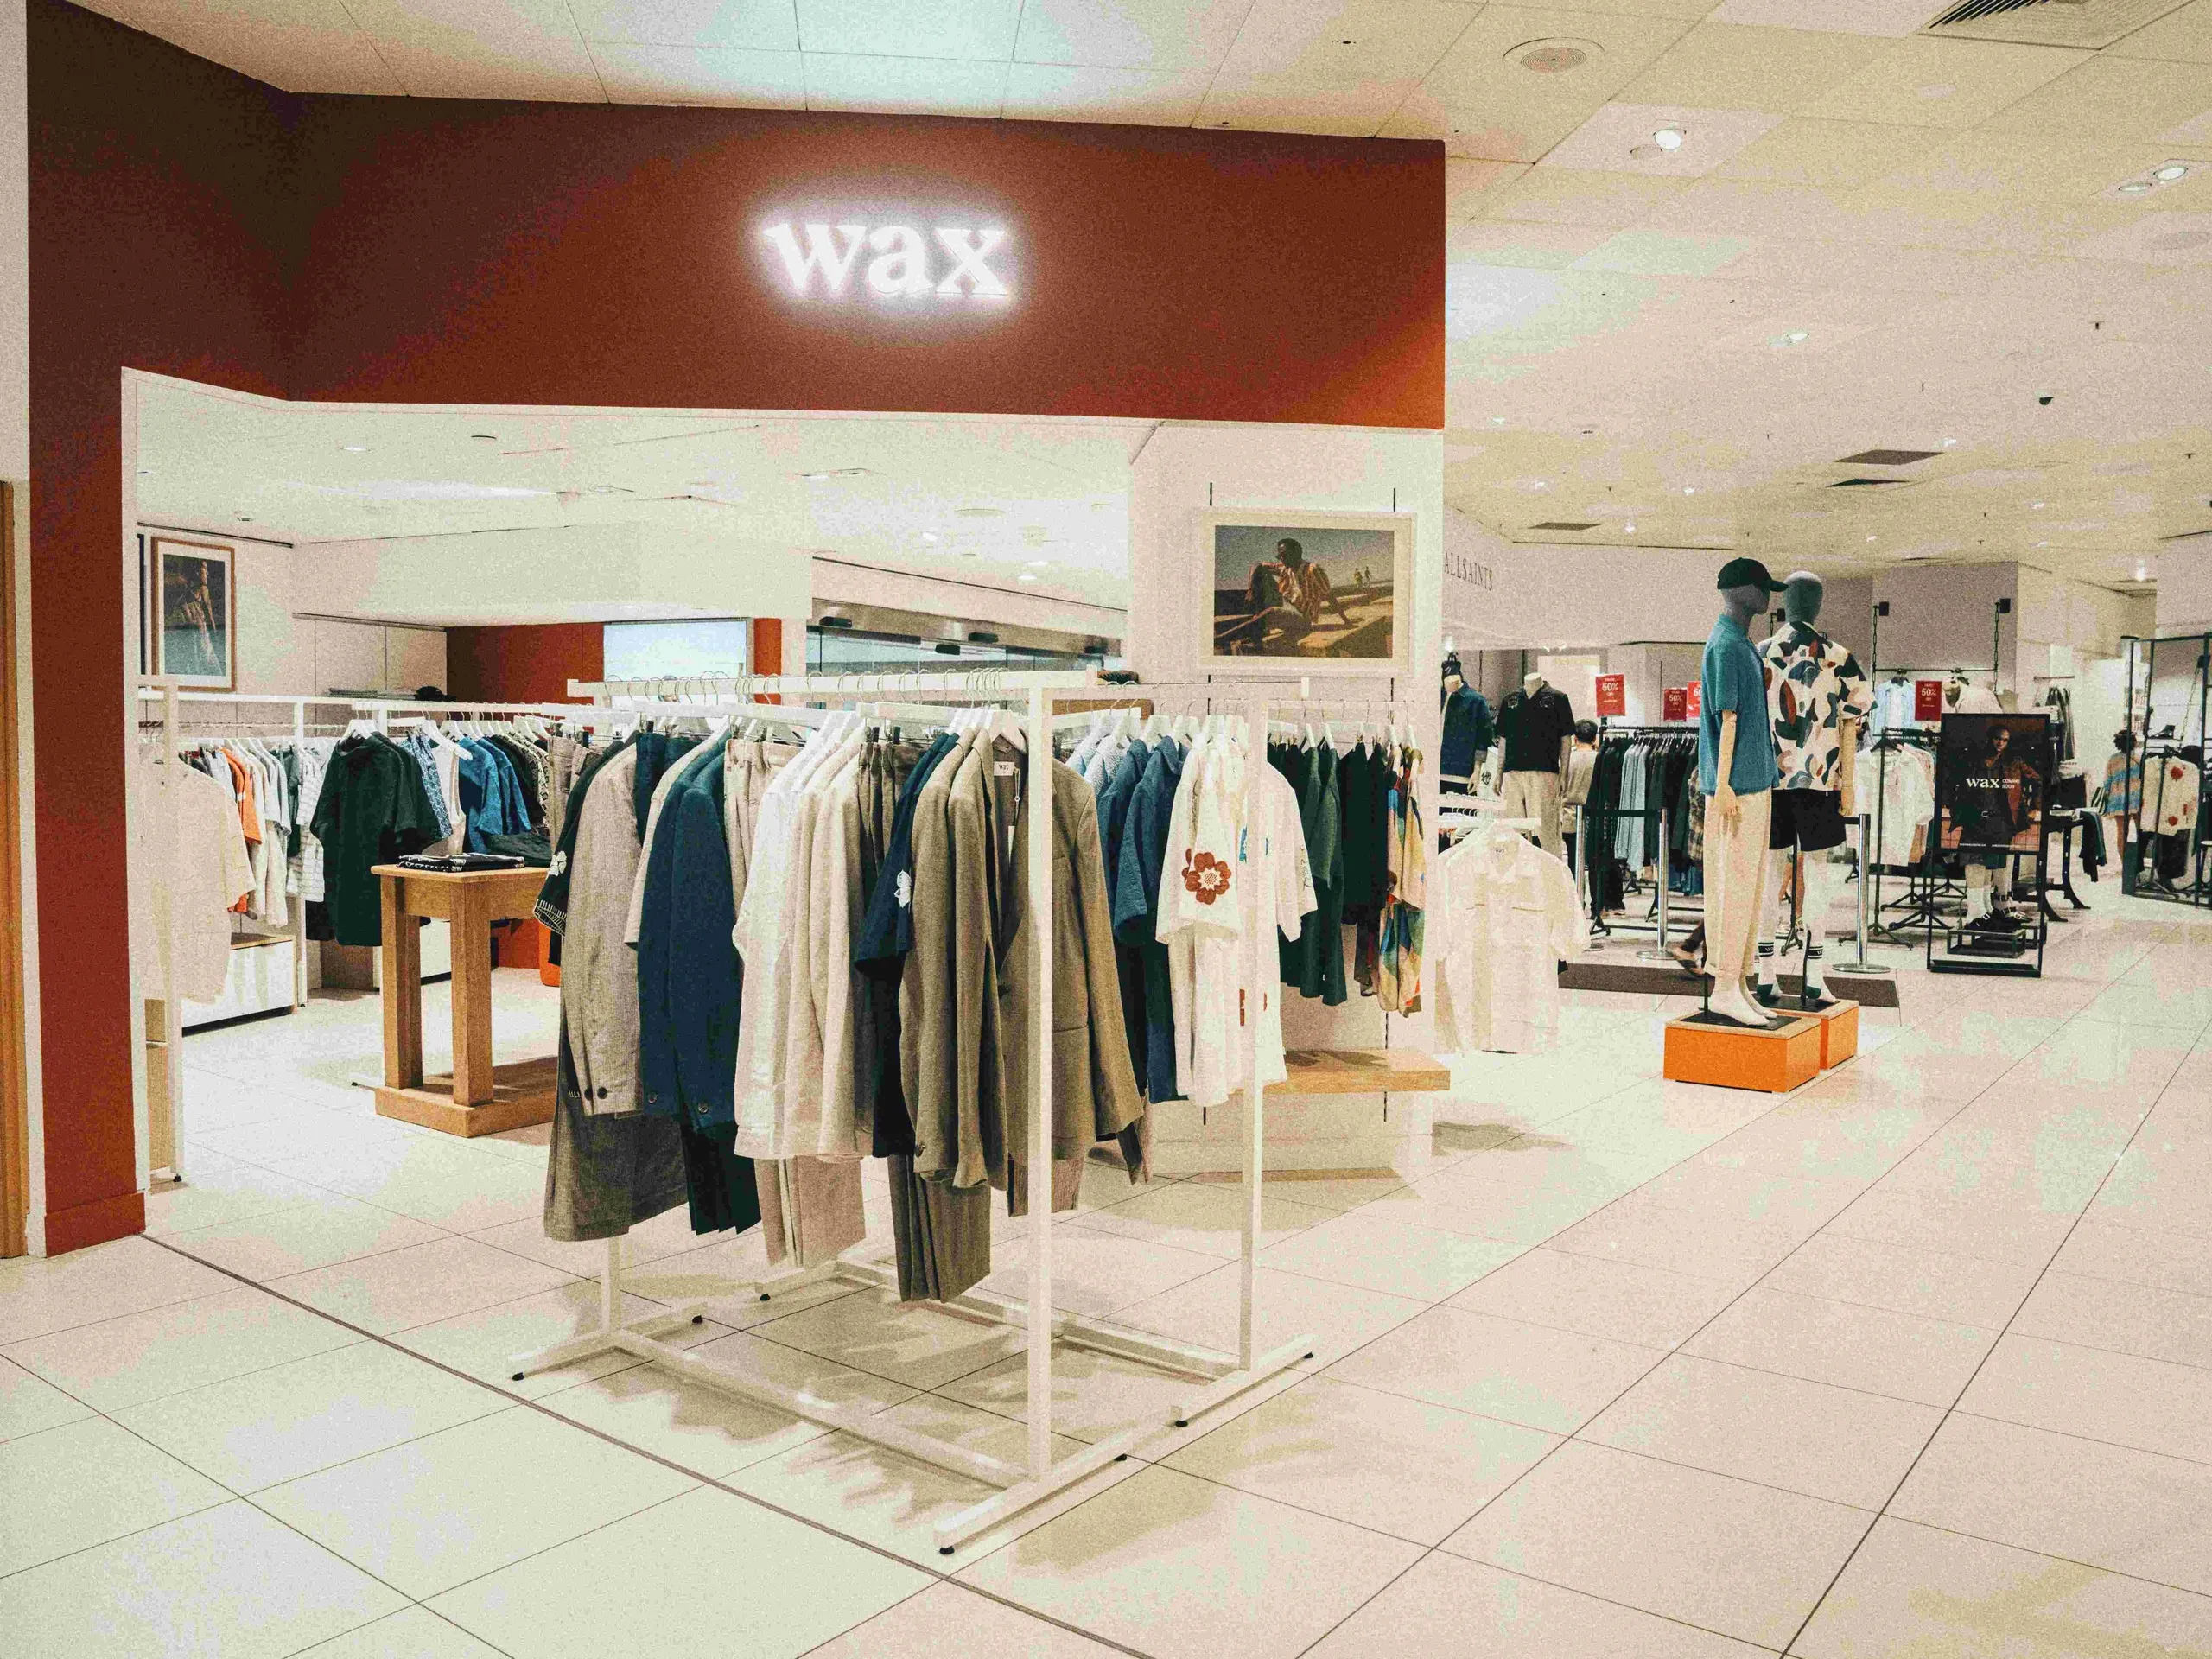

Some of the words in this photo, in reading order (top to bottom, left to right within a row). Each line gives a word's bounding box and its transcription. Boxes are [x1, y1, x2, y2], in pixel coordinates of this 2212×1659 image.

[762, 222, 1009, 297] wax
[1444, 551, 1493, 591] ALLSAINTS
[1602, 682, 1618, 691] 50%
[1921, 688, 1936, 696] 50%
[1966, 778, 2000, 788] wax
